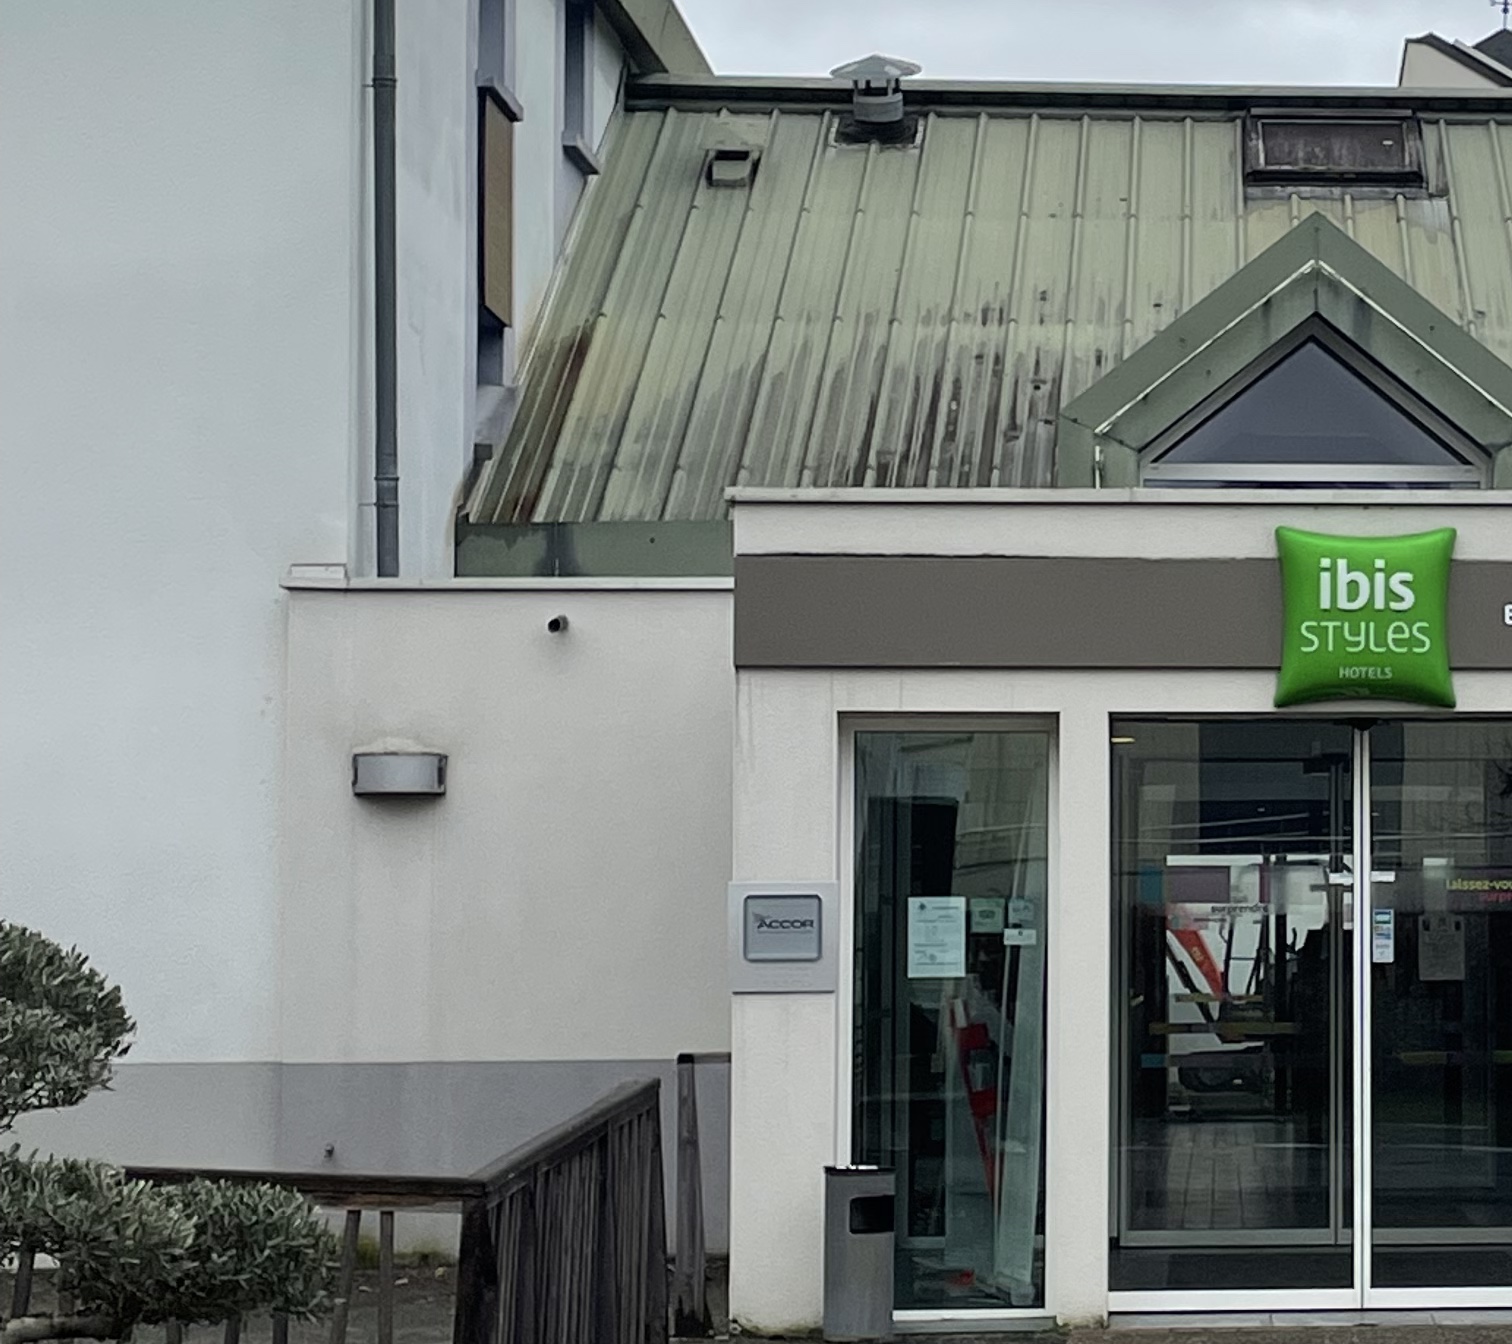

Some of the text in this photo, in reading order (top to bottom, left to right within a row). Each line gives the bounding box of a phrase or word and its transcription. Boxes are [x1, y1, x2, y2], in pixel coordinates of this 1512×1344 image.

[1319, 557, 1416, 611] ibis
[1338, 666, 1393, 680] HOTELS
[756, 919, 815, 930] ACCOR
